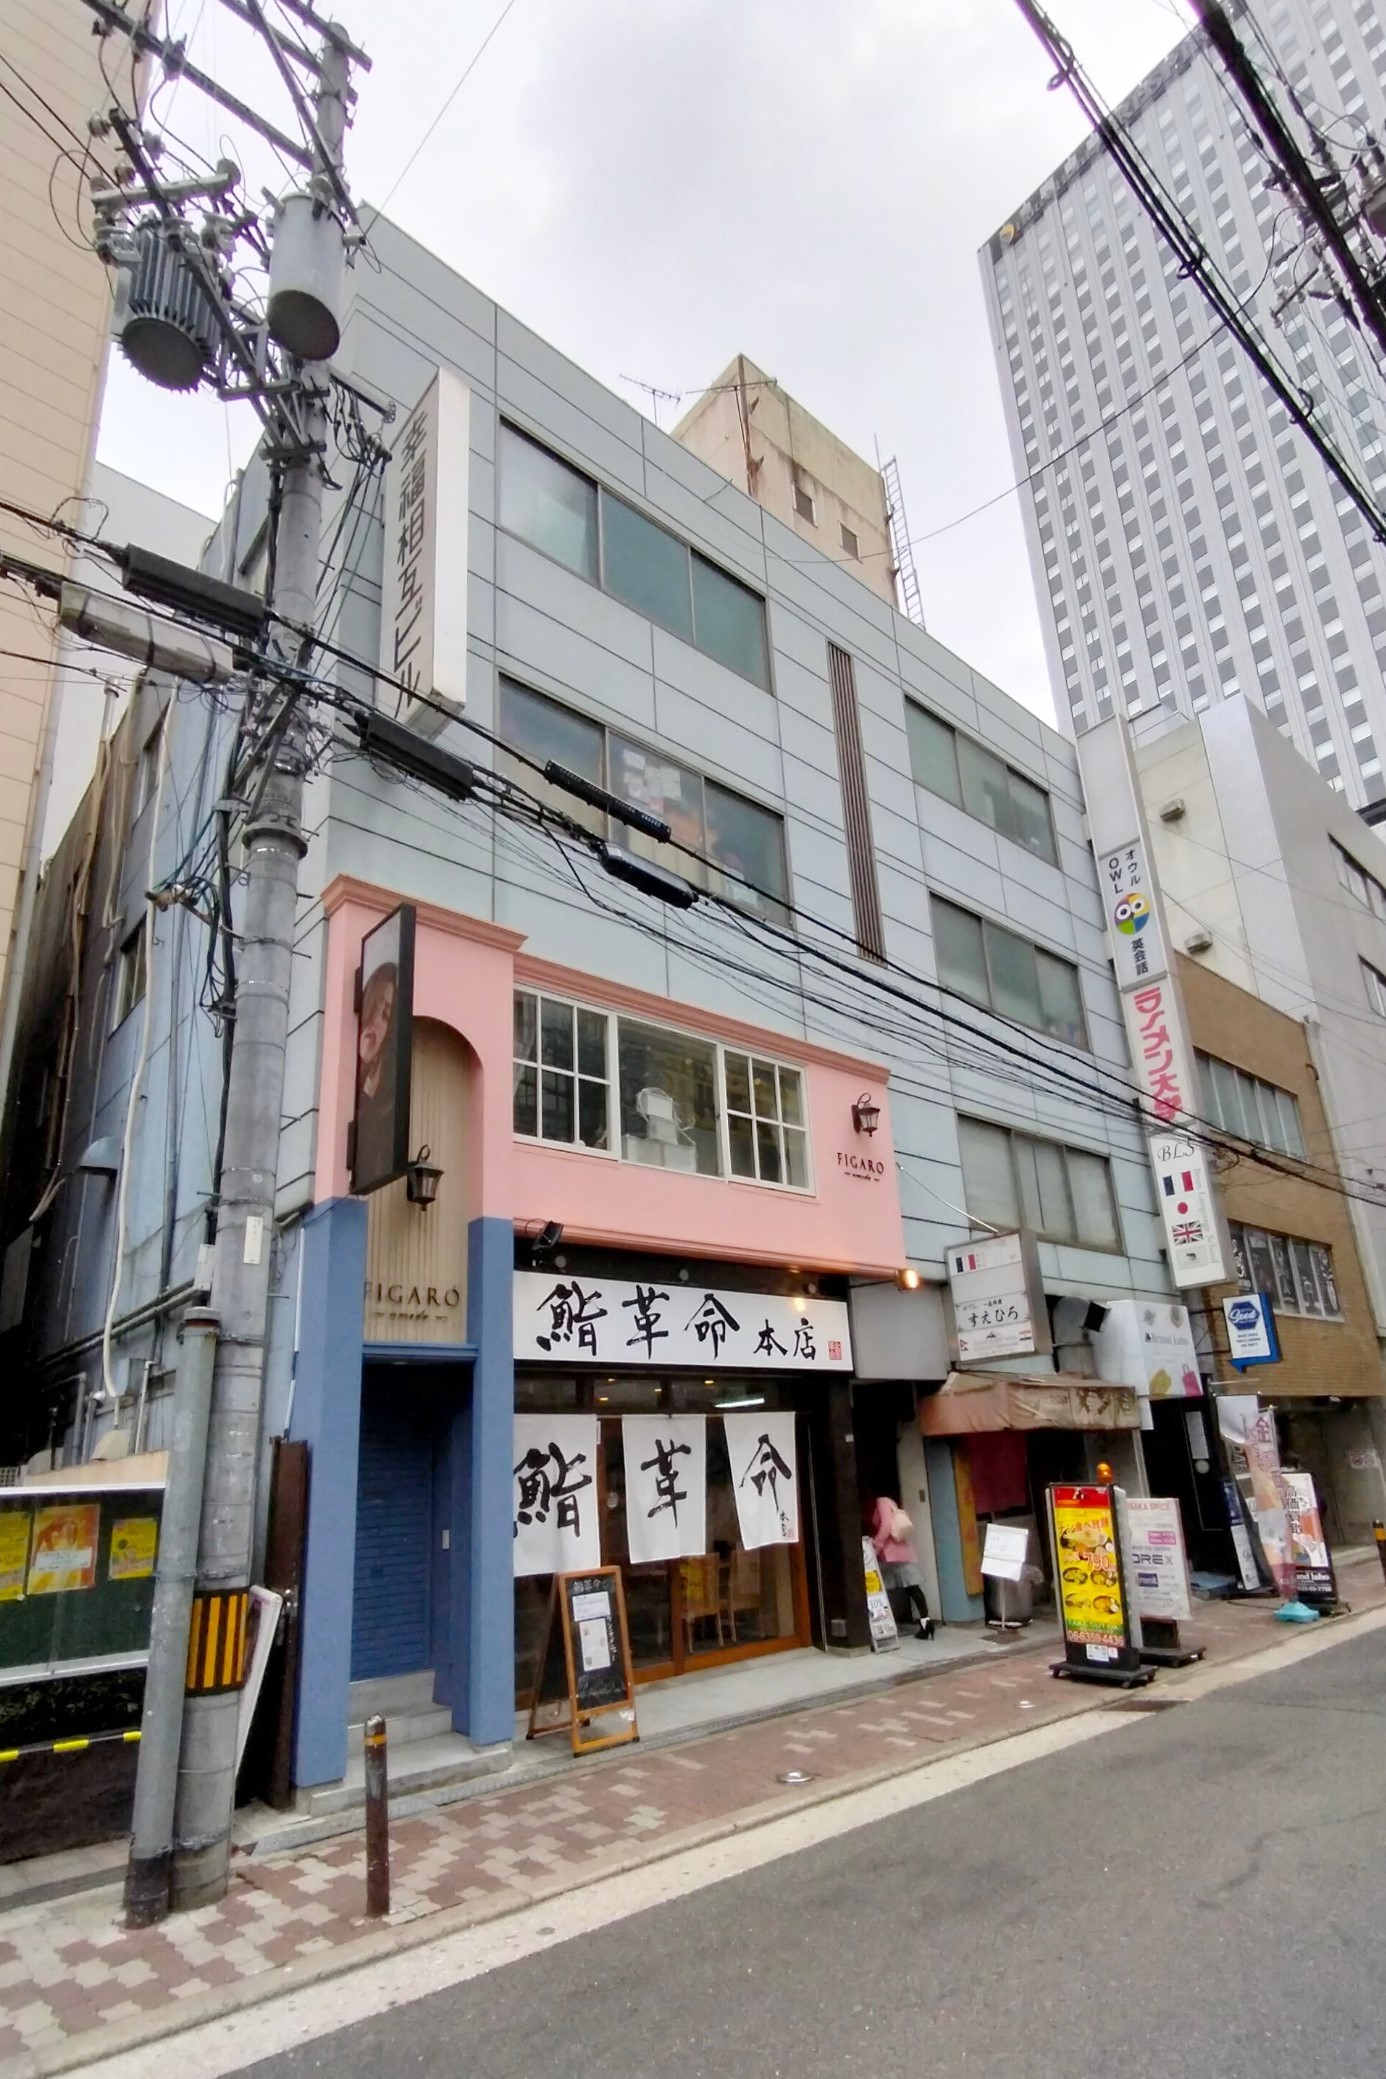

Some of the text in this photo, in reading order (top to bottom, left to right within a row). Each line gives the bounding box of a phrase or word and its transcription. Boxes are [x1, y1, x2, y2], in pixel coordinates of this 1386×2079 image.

[394, 410, 427, 718] 幸福相互ビル
[1109, 858, 1123, 893] OWL
[1125, 850, 1141, 886] オウル
[1132, 938, 1148, 976] 英会話
[837, 1152, 884, 1174] FIGARO
[365, 1281, 459, 1307] FIGARO
[536, 1281, 815, 1361] 鮨革命 本店
[968, 1306, 1018, 1327] すえひろ
